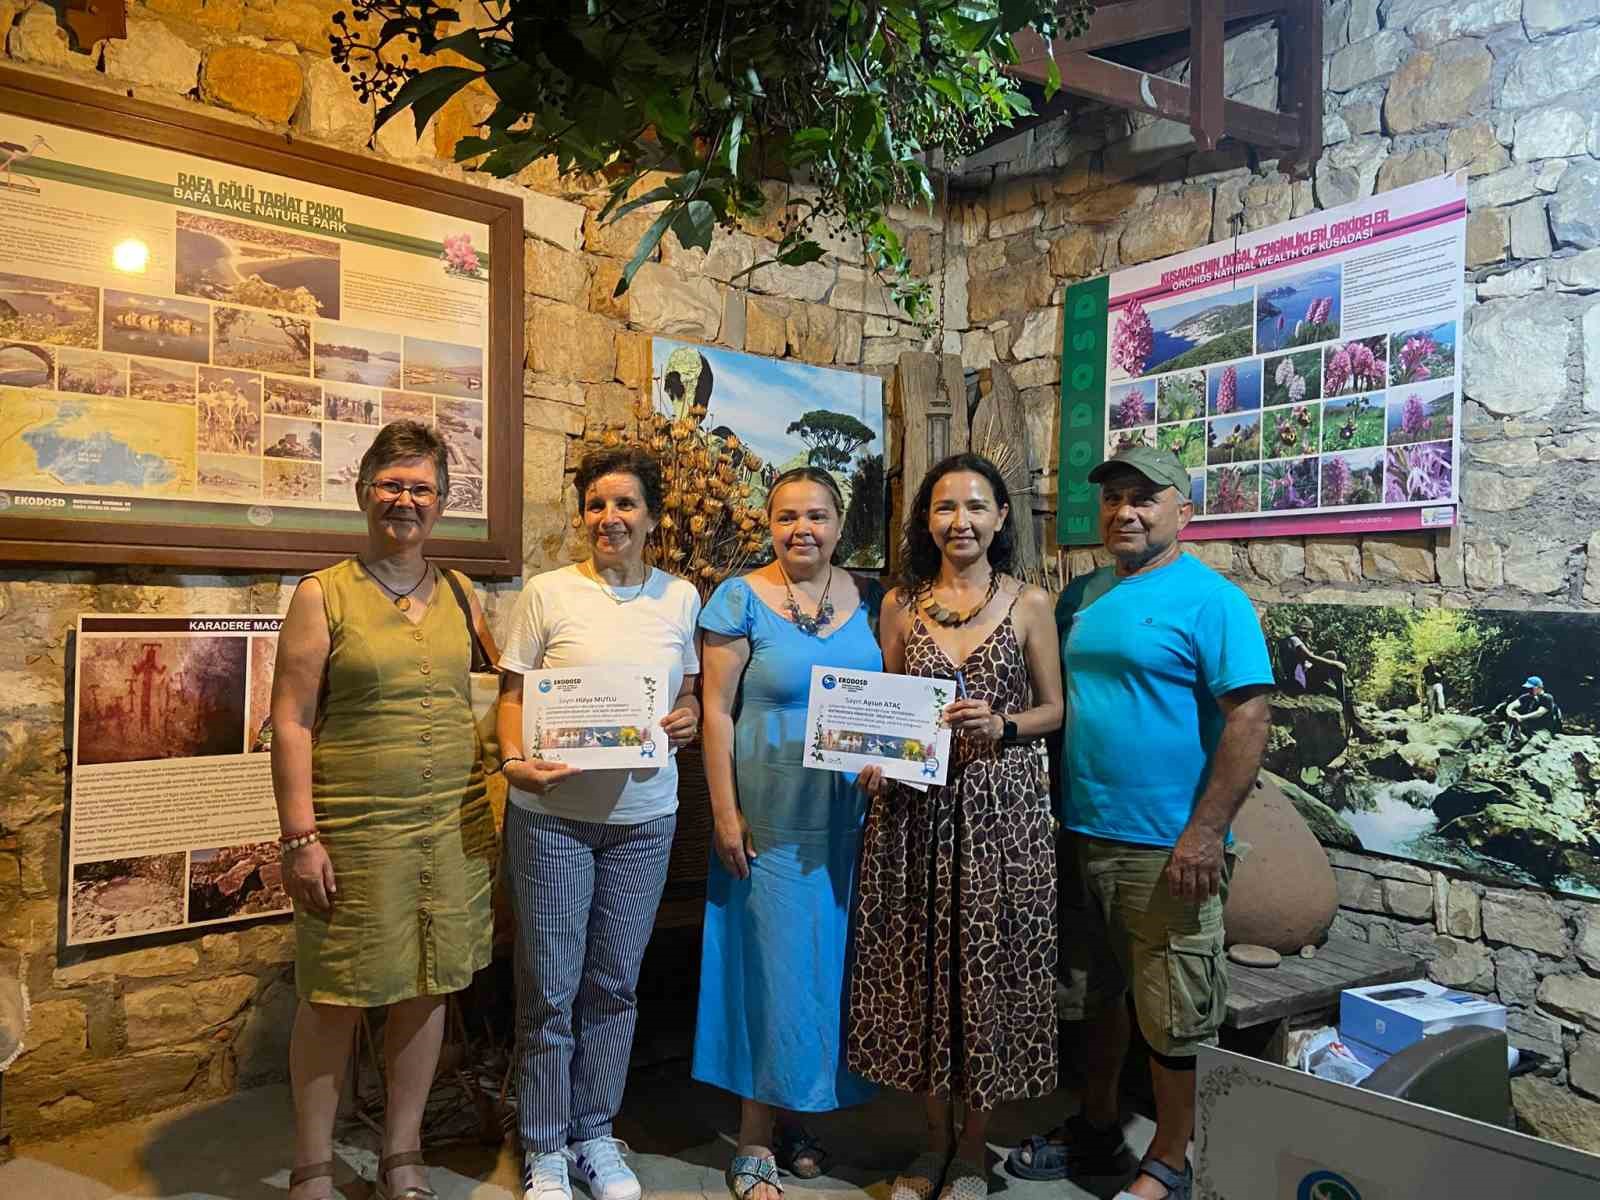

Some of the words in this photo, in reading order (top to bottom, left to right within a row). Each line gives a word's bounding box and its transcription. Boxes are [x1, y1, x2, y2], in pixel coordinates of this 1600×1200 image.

[173, 187, 212, 205] BAFA
[216, 194, 251, 213] LAKE
[255, 204, 309, 225] NATURE
[312, 216, 347, 233] PARK
[177, 172, 214, 194] BAFA
[218, 180, 255, 201] GÖLÜ
[258, 189, 302, 212] TABİAT
[305, 200, 344, 222] PARKI
[1172, 273, 1212, 291] ORCHIDS
[1214, 262, 1257, 280] NATURAL
[1259, 248, 1299, 267] WEALTH
[1301, 243, 1318, 256] OF
[1318, 228, 1374, 251] KUSADASI
[1067, 293, 1097, 534] EKODOSD
[14, 495, 66, 508] EKODOSD
[189, 621, 251, 631] KARADERE
[594, 695, 617, 703] MUTLU
[863, 699, 883, 709] Aysun
[884, 701, 901, 710] ATAÇ
